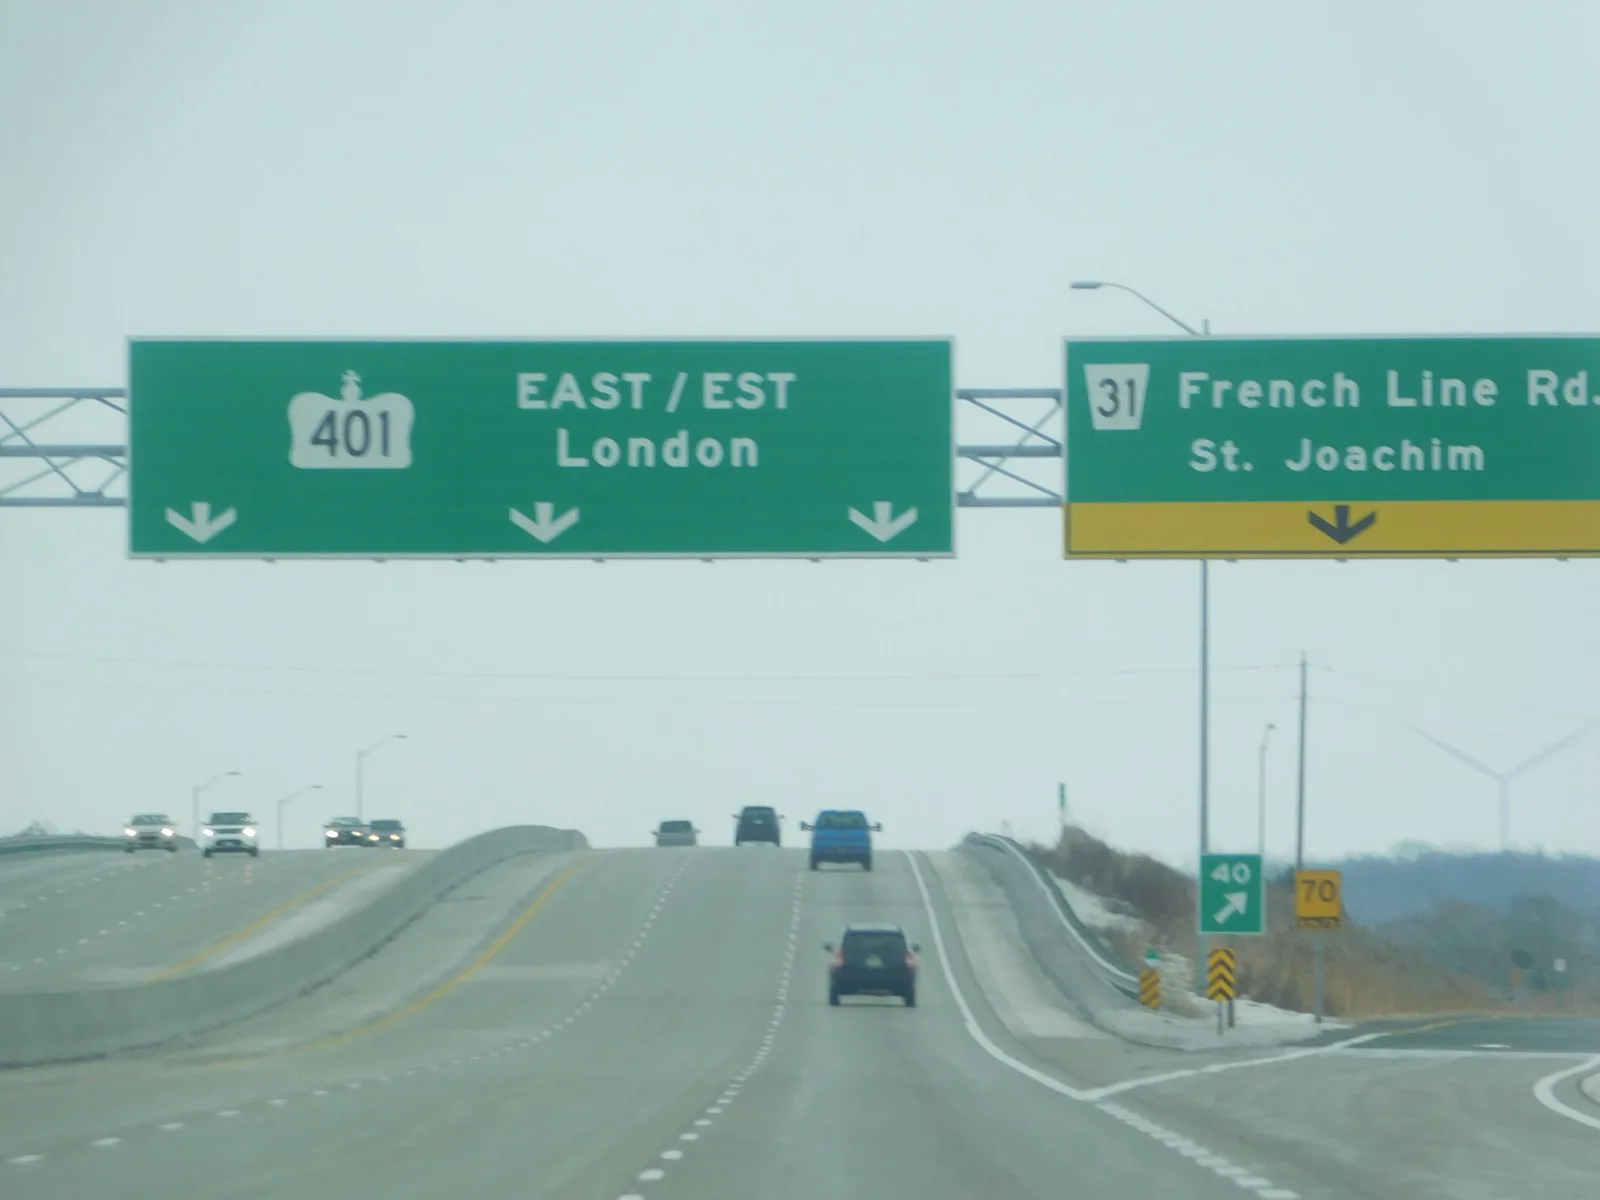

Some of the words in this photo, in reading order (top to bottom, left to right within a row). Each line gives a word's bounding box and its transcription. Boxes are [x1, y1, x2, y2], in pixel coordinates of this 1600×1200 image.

[517, 371, 652, 411] EAST
[665, 371, 689, 413] /
[703, 371, 797, 411] EST
[1096, 377, 1139, 418] 31
[1179, 371, 1360, 409] French
[1387, 369, 1498, 407] Line
[310, 409, 390, 458] 401
[557, 427, 759, 468] London
[1189, 438, 1254, 473] St.
[1285, 437, 1485, 472] Joachim
[1210, 862, 1251, 885] 40
[1300, 879, 1337, 903] 70
